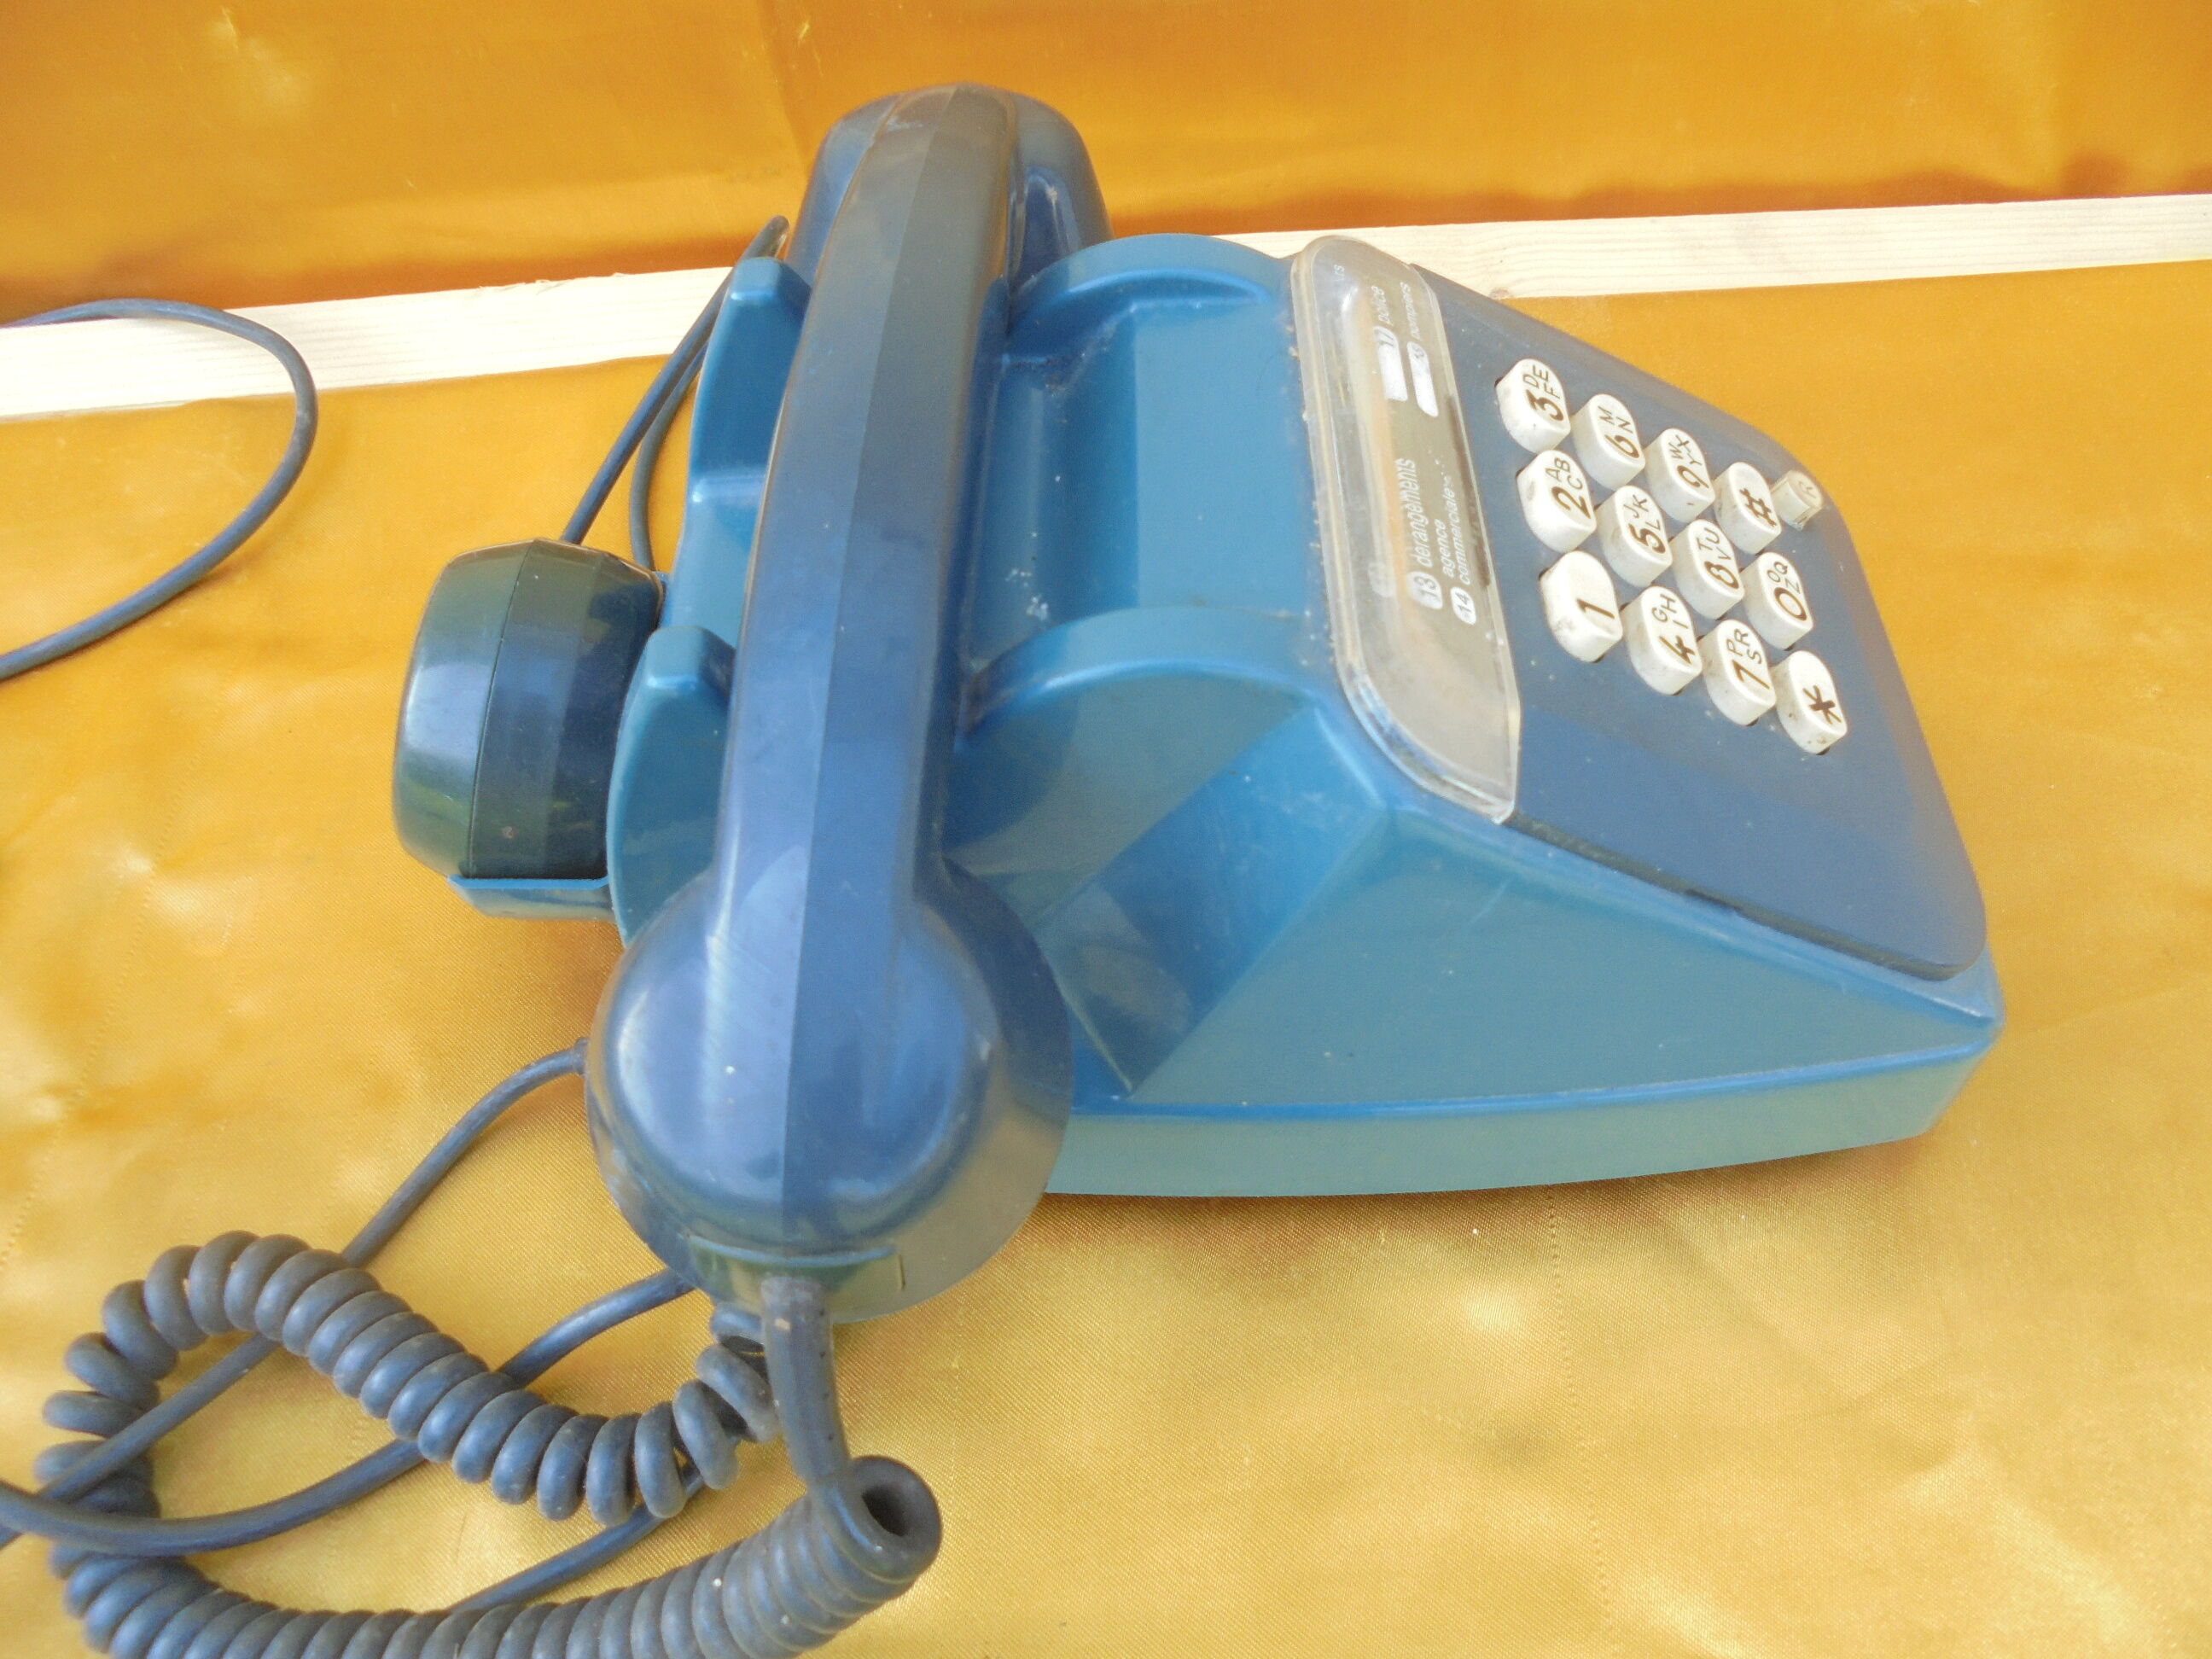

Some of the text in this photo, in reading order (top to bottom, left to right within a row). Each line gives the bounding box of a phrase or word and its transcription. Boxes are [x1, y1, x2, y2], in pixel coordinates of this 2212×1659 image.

[1371, 285, 1394, 326] police
[1400, 282, 1422, 341] pompiers
[1526, 389, 1564, 421] 3
[1605, 434, 1639, 458] 6
[1677, 465, 1709, 489] 9
[1551, 486, 1591, 519] 2
[1435, 518, 1455, 579] agence
[1442, 484, 1470, 585] commerciale
[1629, 523, 1666, 554] 5
[1704, 561, 1740, 590] 8
[1458, 590, 1473, 614] 14
[1576, 598, 1615, 620] 1
[1774, 586, 1807, 620] 0
[1659, 635, 1696, 665] 4
[1732, 660, 1770, 690] 7
